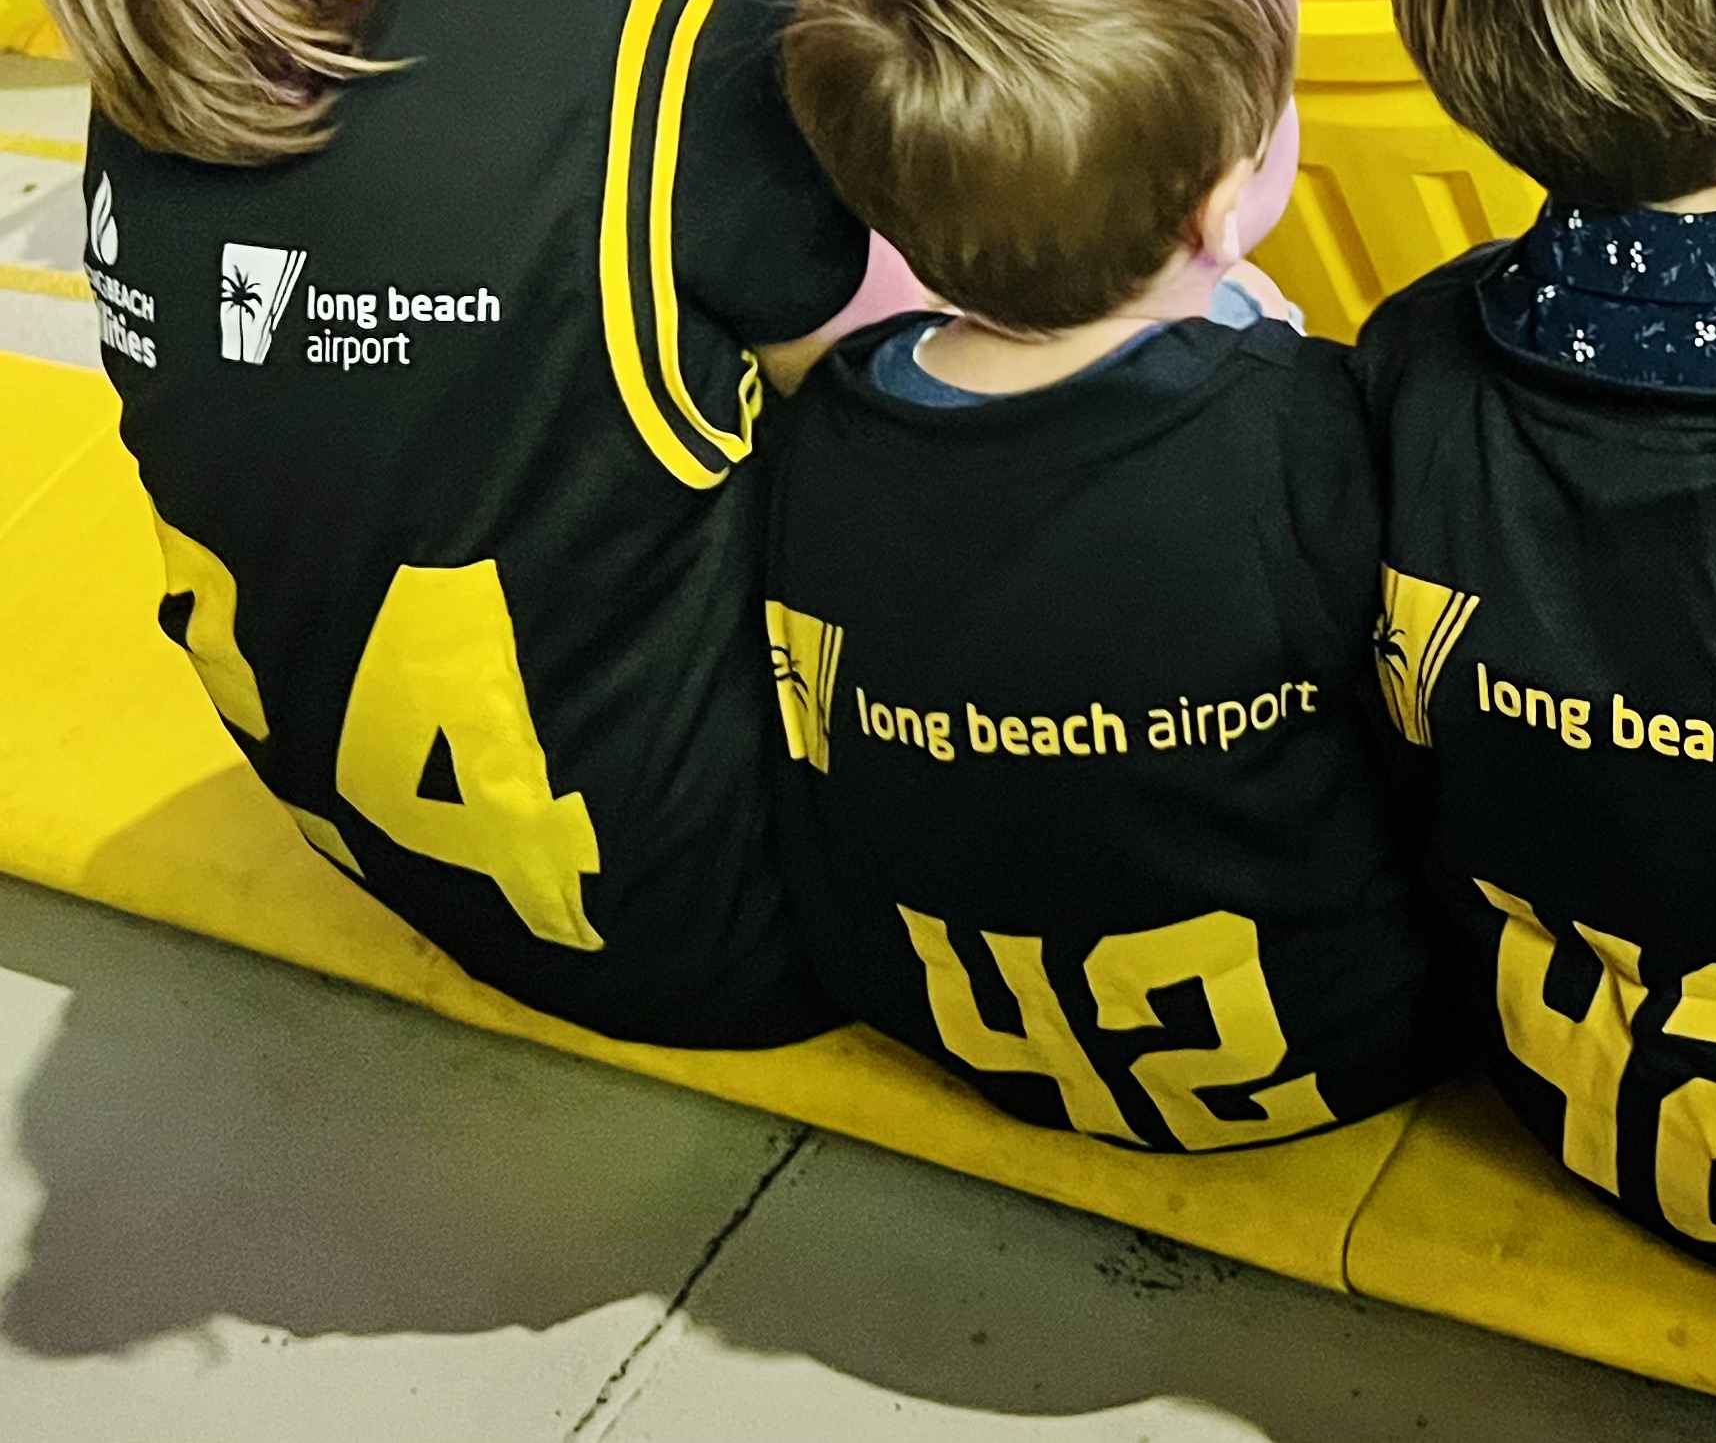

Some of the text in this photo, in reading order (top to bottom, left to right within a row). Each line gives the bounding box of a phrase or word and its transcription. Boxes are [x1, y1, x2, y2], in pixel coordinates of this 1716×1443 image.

[307, 285, 500, 329] long beach
[307, 329, 410, 371] airport
[856, 681, 1319, 762] long beach airport
[1476, 662, 1592, 750] long
[894, 902, 1339, 1152] 42
